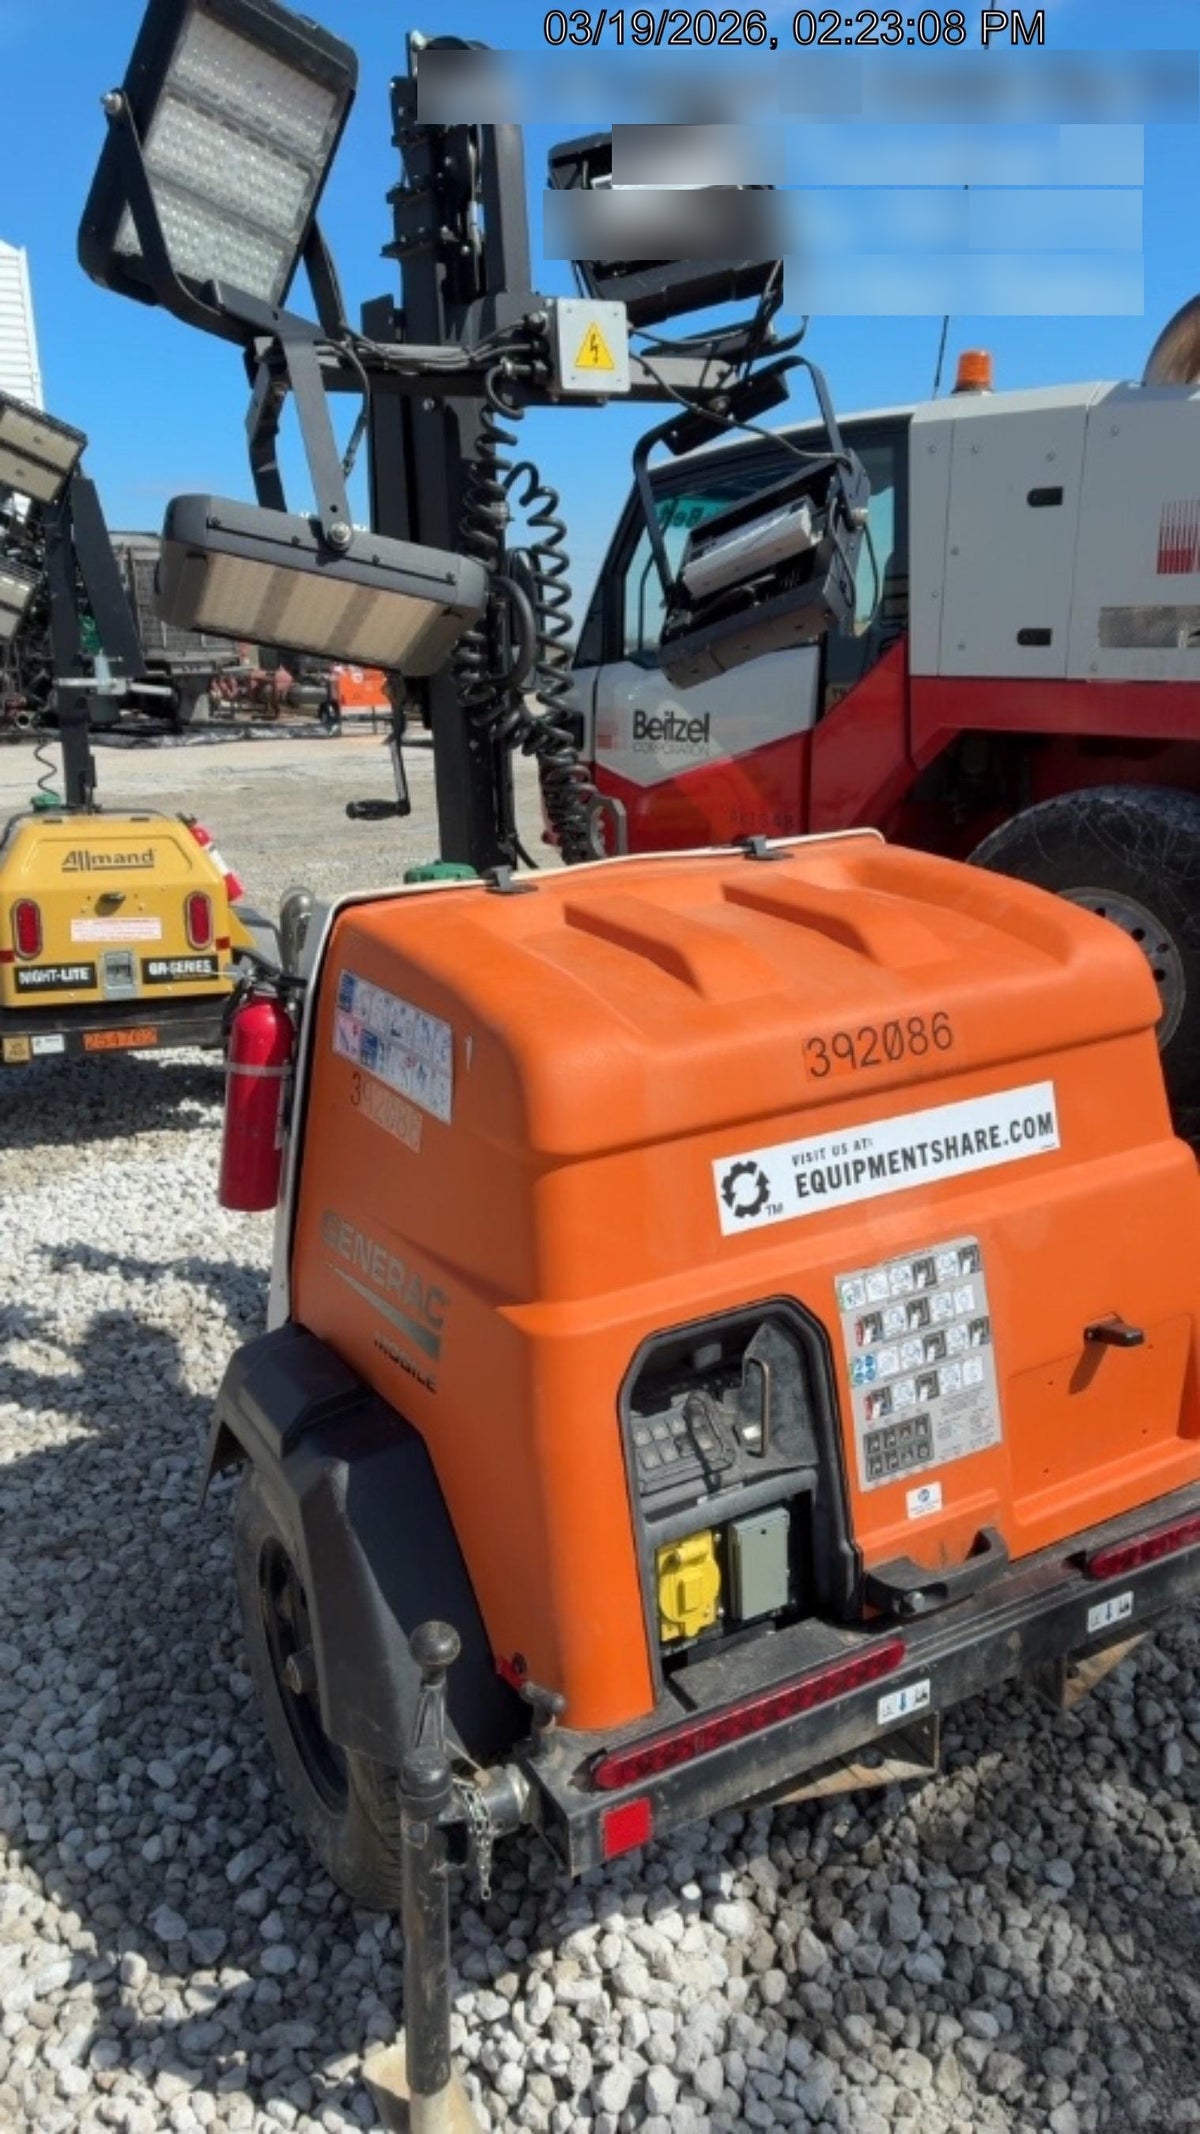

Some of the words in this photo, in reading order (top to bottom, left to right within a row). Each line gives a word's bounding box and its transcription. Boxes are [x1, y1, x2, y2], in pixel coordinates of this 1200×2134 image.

[633, 709, 710, 743] Beitzel
[62, 849, 154, 872] Allmand
[19, 967, 90, 985] NIGHT-LITE
[149, 959, 212, 976] GR-SERIES
[806, 1011, 954, 1078] 392086
[792, 1147, 825, 1168] VISIT
[832, 1142, 848, 1158] US
[795, 1111, 1054, 1199] EQUIPMENTSHARE.COM
[322, 1208, 450, 1329] GENERAC
